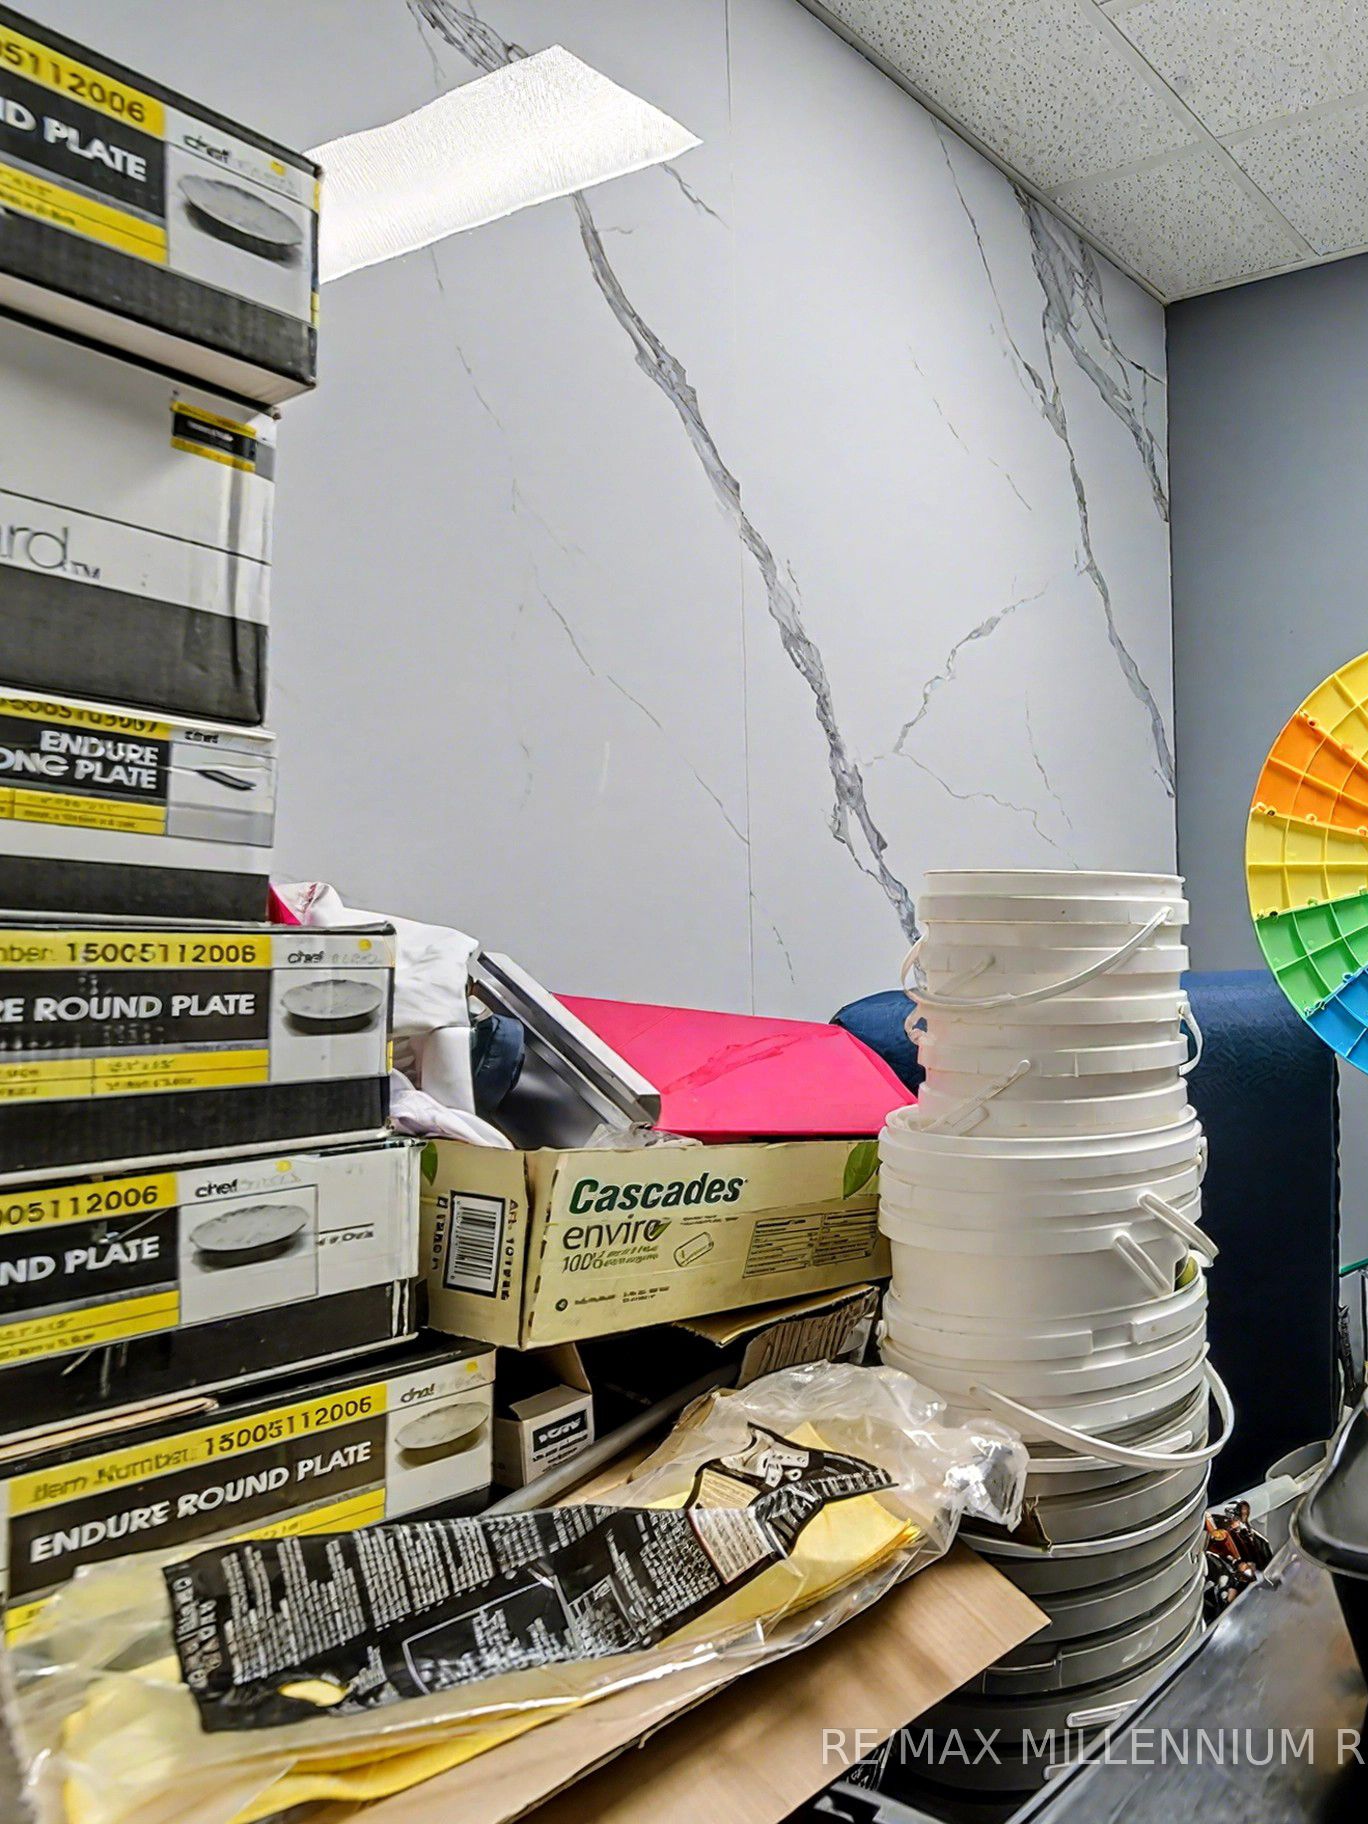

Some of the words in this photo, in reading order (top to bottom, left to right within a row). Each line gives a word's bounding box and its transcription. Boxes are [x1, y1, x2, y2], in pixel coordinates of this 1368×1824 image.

[0, 36, 147, 124] 5112006
[42, 115, 148, 183] PLATE
[40, 730, 160, 767] ENDURE
[74, 758, 158, 790] PLATE
[33, 994, 162, 1023] ROUND
[171, 992, 256, 1018] PLATE
[0, 1184, 159, 1227] 05112006
[568, 1171, 746, 1216] Cascades
[64, 1235, 161, 1275] PLATE
[29, 1499, 172, 1564] ENDURE
[175, 1466, 291, 1520] ROUND
[296, 1440, 372, 1483] PLATE
